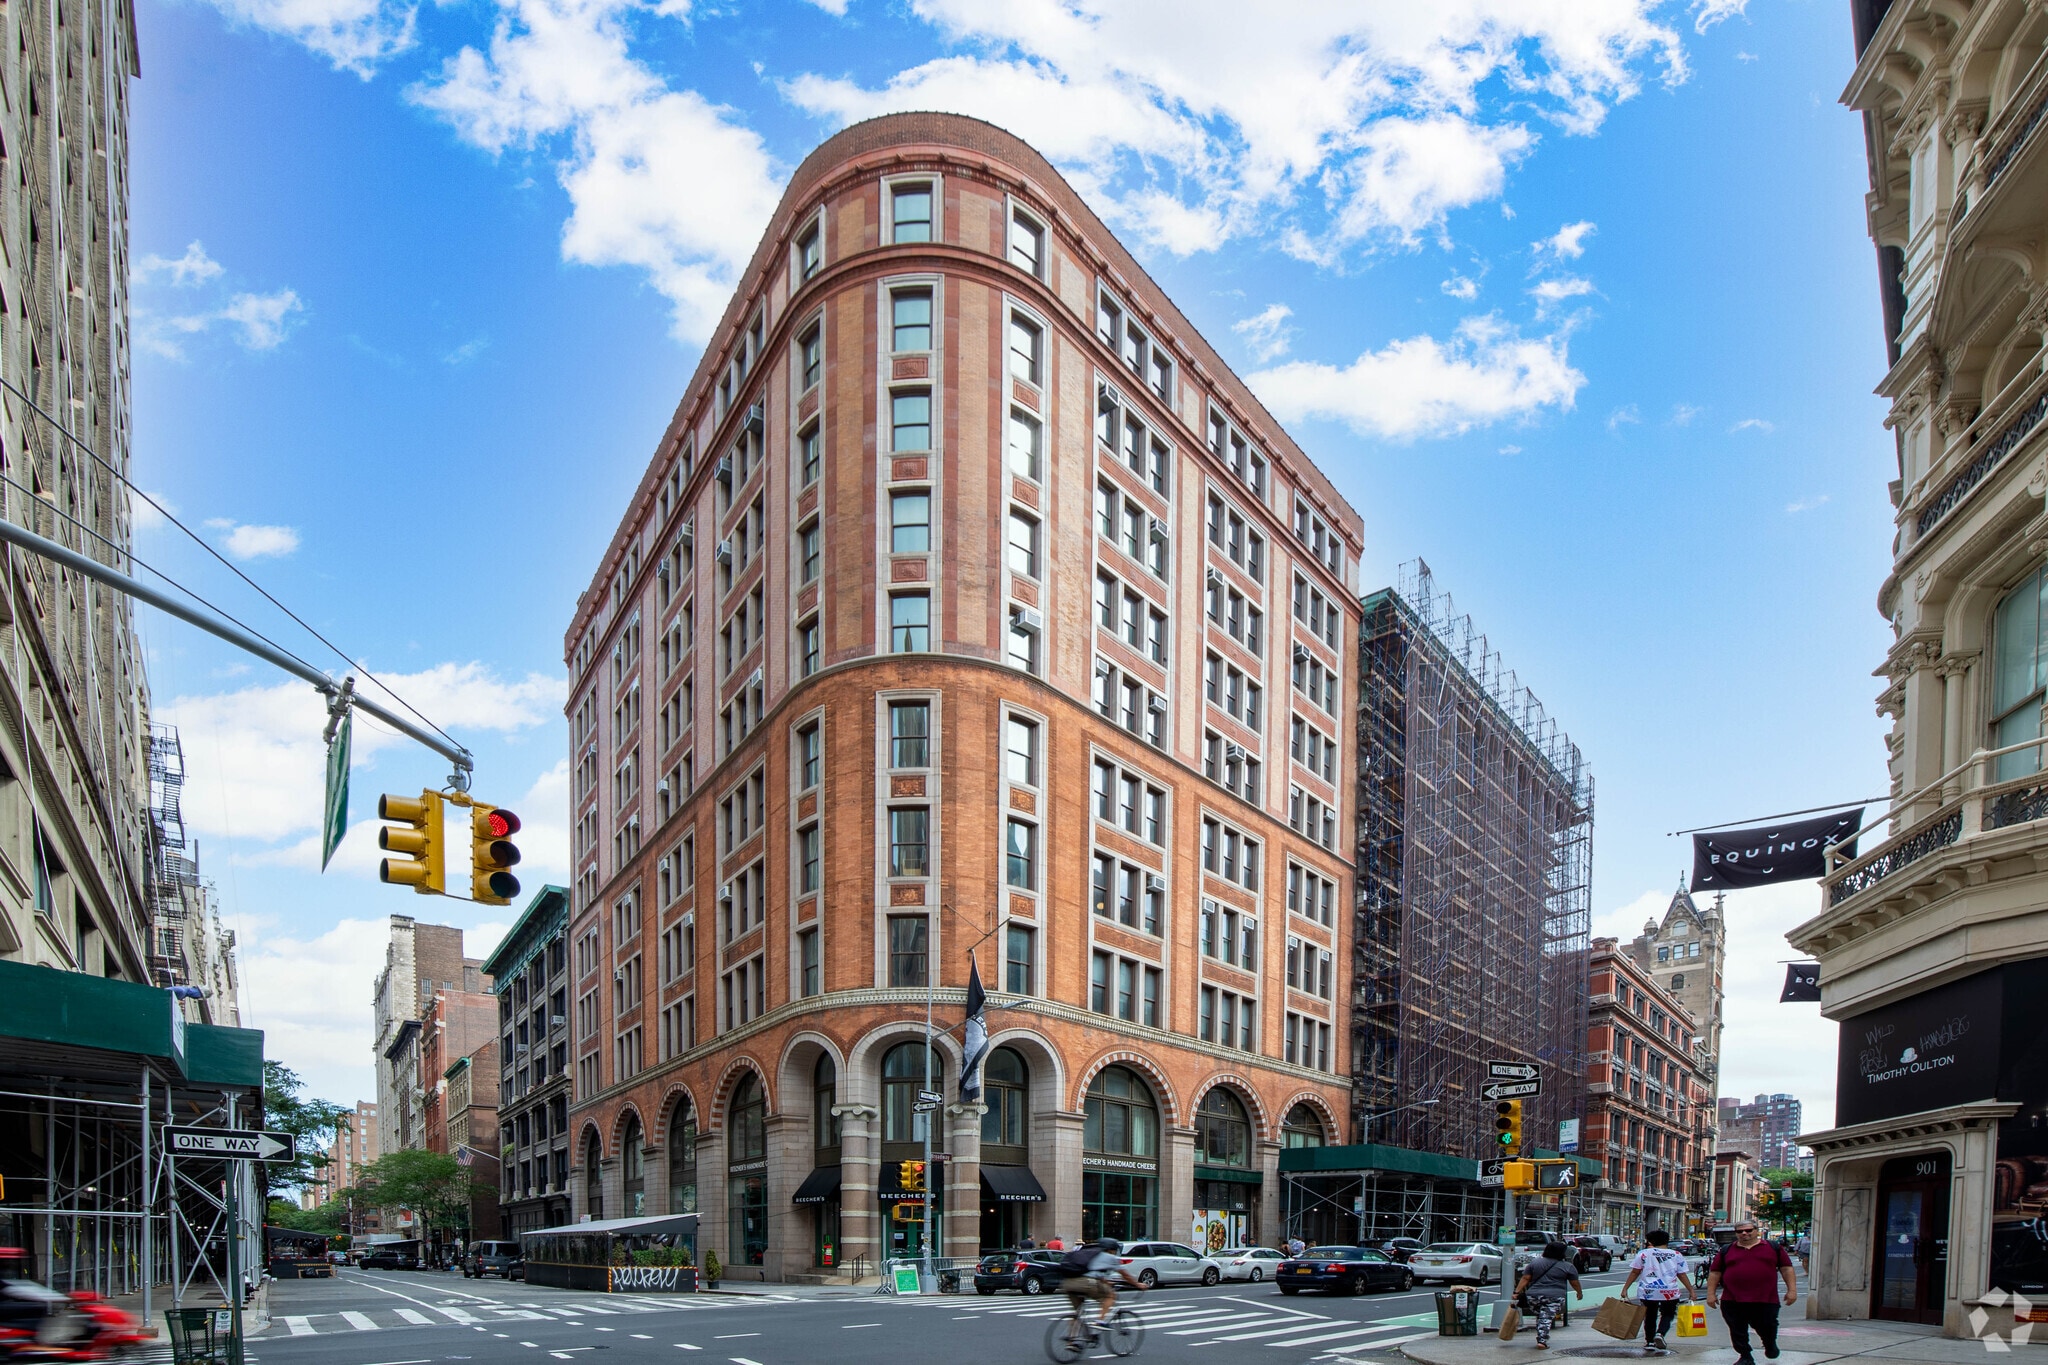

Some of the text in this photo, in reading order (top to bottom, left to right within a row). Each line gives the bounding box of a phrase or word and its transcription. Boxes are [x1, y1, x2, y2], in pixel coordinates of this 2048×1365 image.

[1711, 834, 1839, 865] EQUINOX
[1496, 1066, 1532, 1076] ONE WAY
[1490, 1084, 1533, 1096] ONE WAY
[179, 1136, 260, 1151] ONE WAY
[1107, 1159, 1136, 1169] HANDMADE
[1136, 1162, 1157, 1170] CHEESE
[1916, 1160, 1937, 1176] 901
[1482, 1176, 1498, 1185] BIKE
